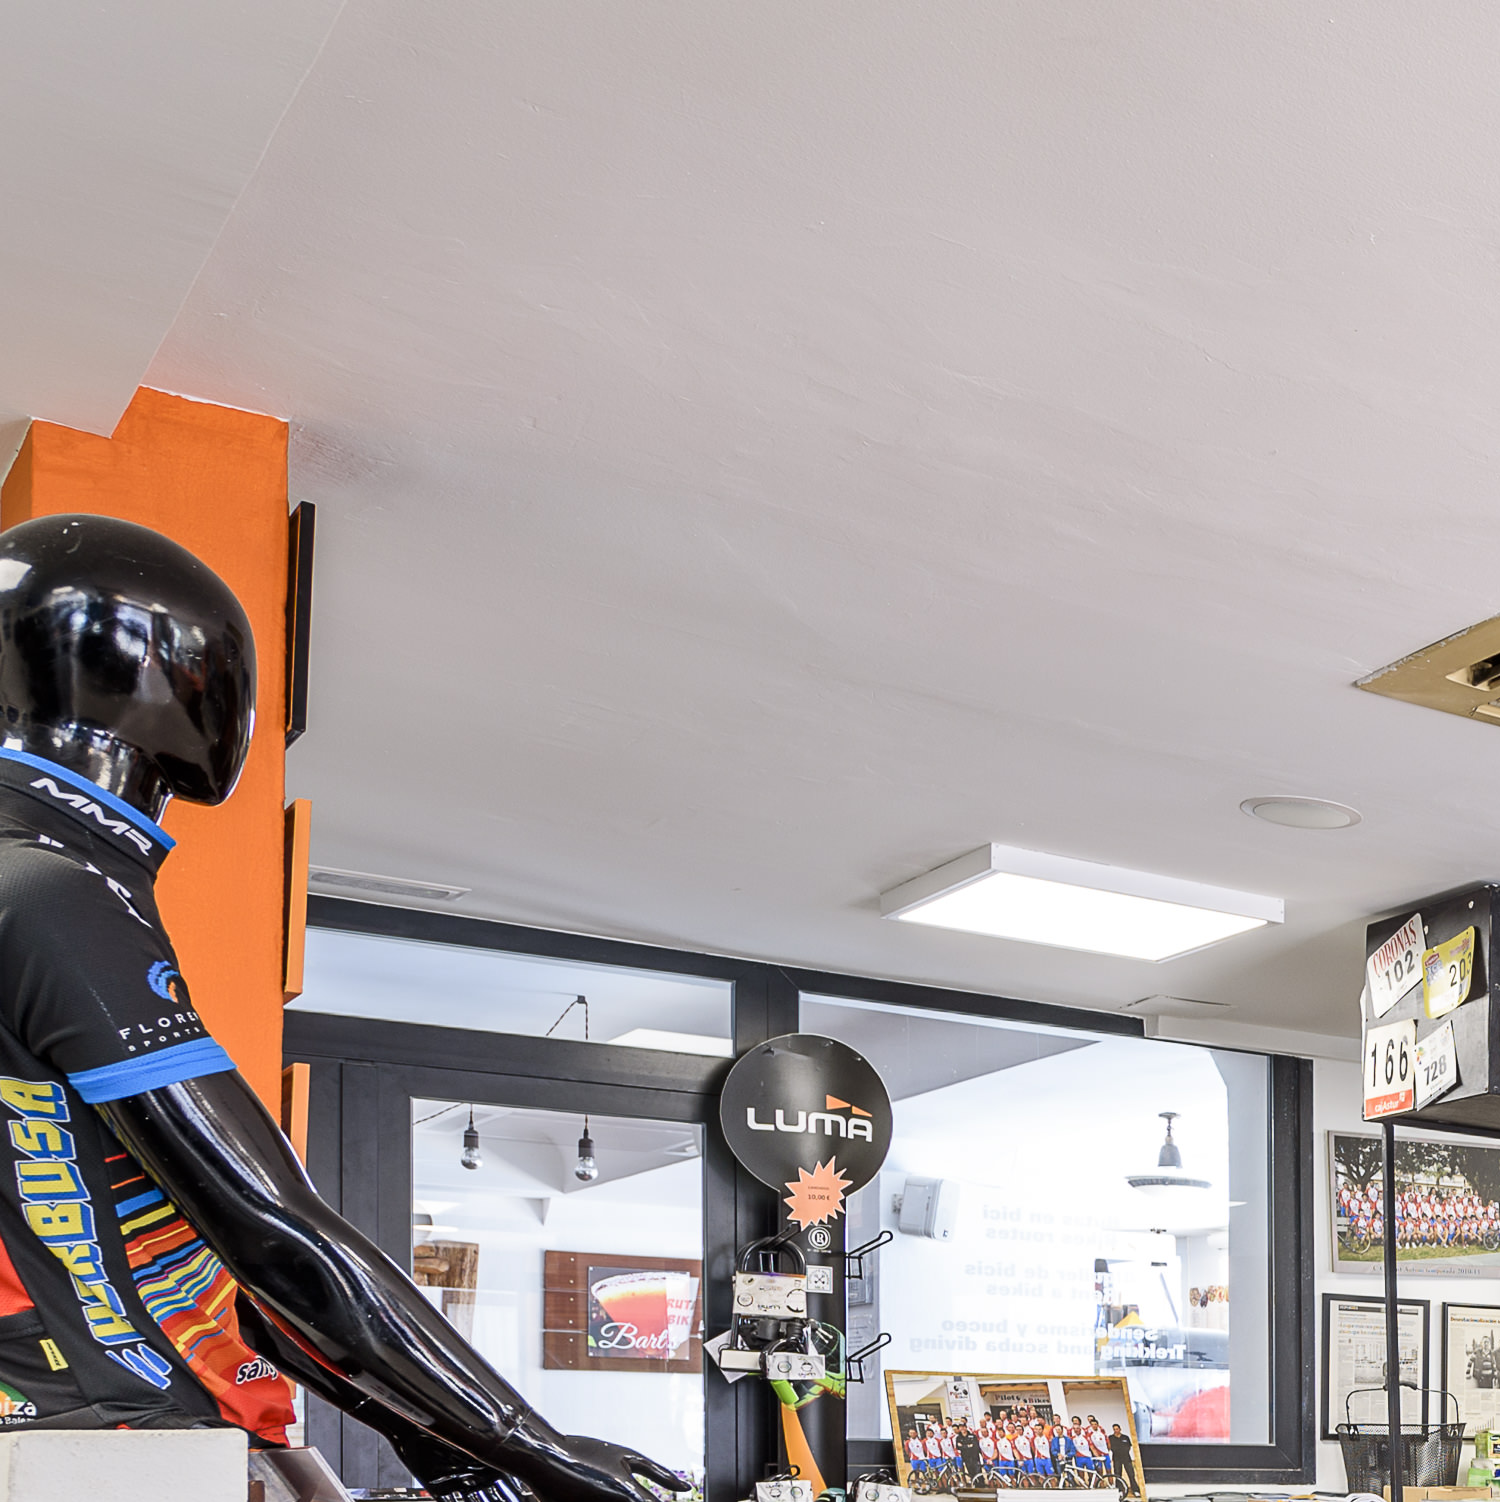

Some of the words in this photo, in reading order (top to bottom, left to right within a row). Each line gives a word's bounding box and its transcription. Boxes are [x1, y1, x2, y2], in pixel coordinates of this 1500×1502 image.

[30, 778, 152, 855] MMR
[1373, 920, 1417, 978] CORONAS
[1385, 950, 1415, 990] 102
[1371, 1035, 1408, 1087] 166
[1424, 1055, 1447, 1086] 728
[746, 1105, 874, 1143] LUMA
